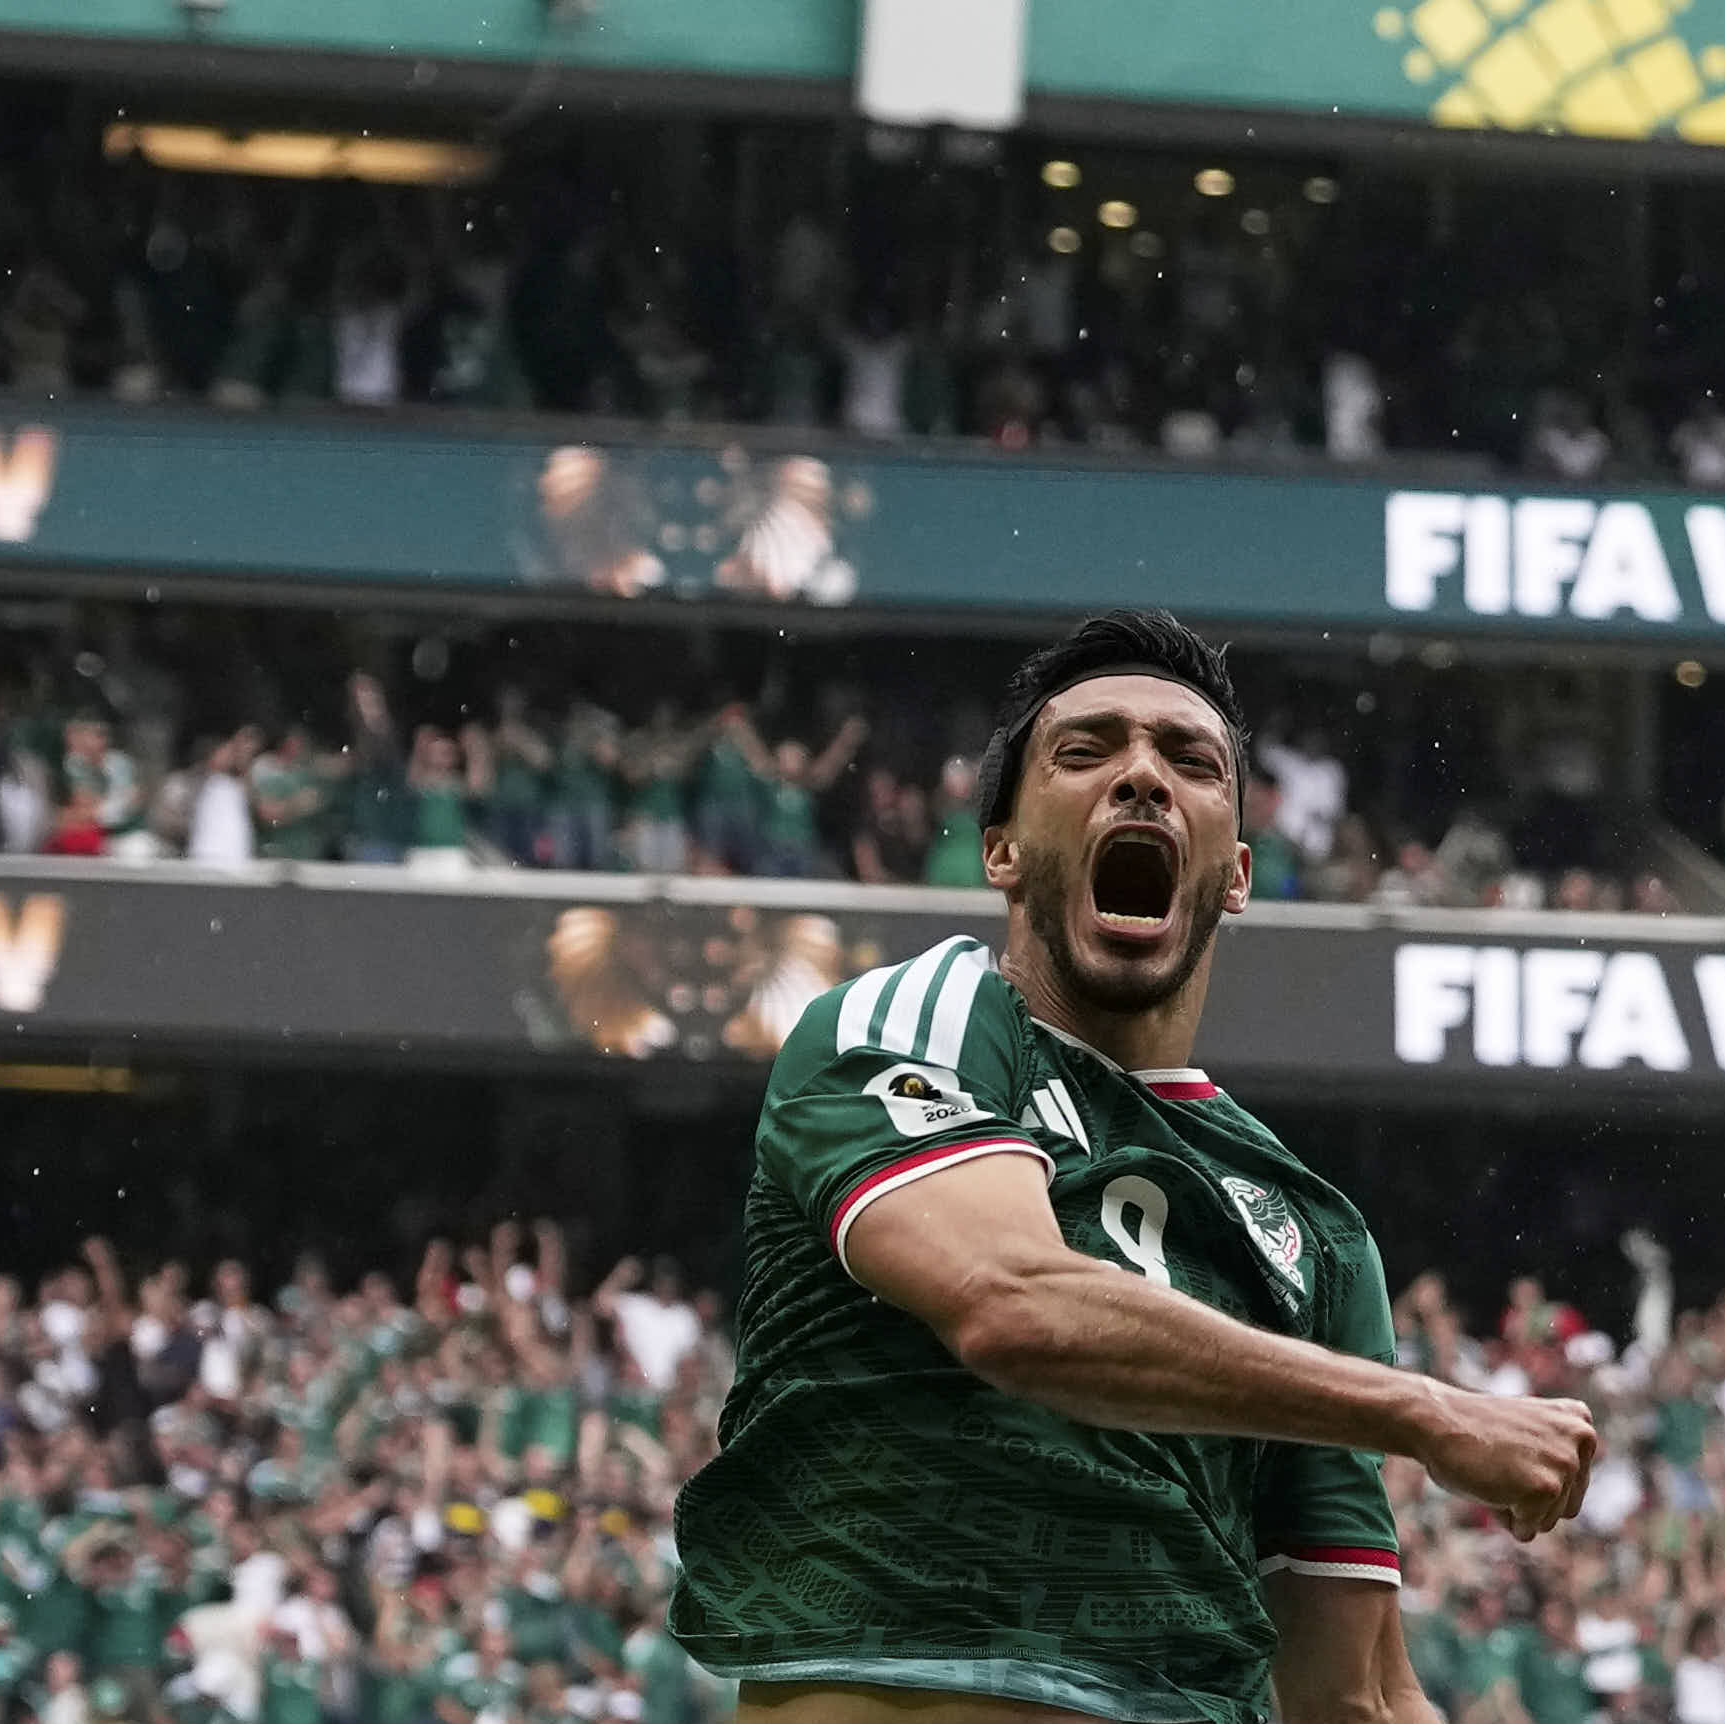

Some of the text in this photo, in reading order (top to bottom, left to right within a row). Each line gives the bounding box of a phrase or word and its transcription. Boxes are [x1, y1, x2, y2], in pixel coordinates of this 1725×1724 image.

[1384, 490, 1684, 624] FIFA
[1394, 943, 1692, 1072] FIFA
[1100, 1174, 1172, 1288] 9
